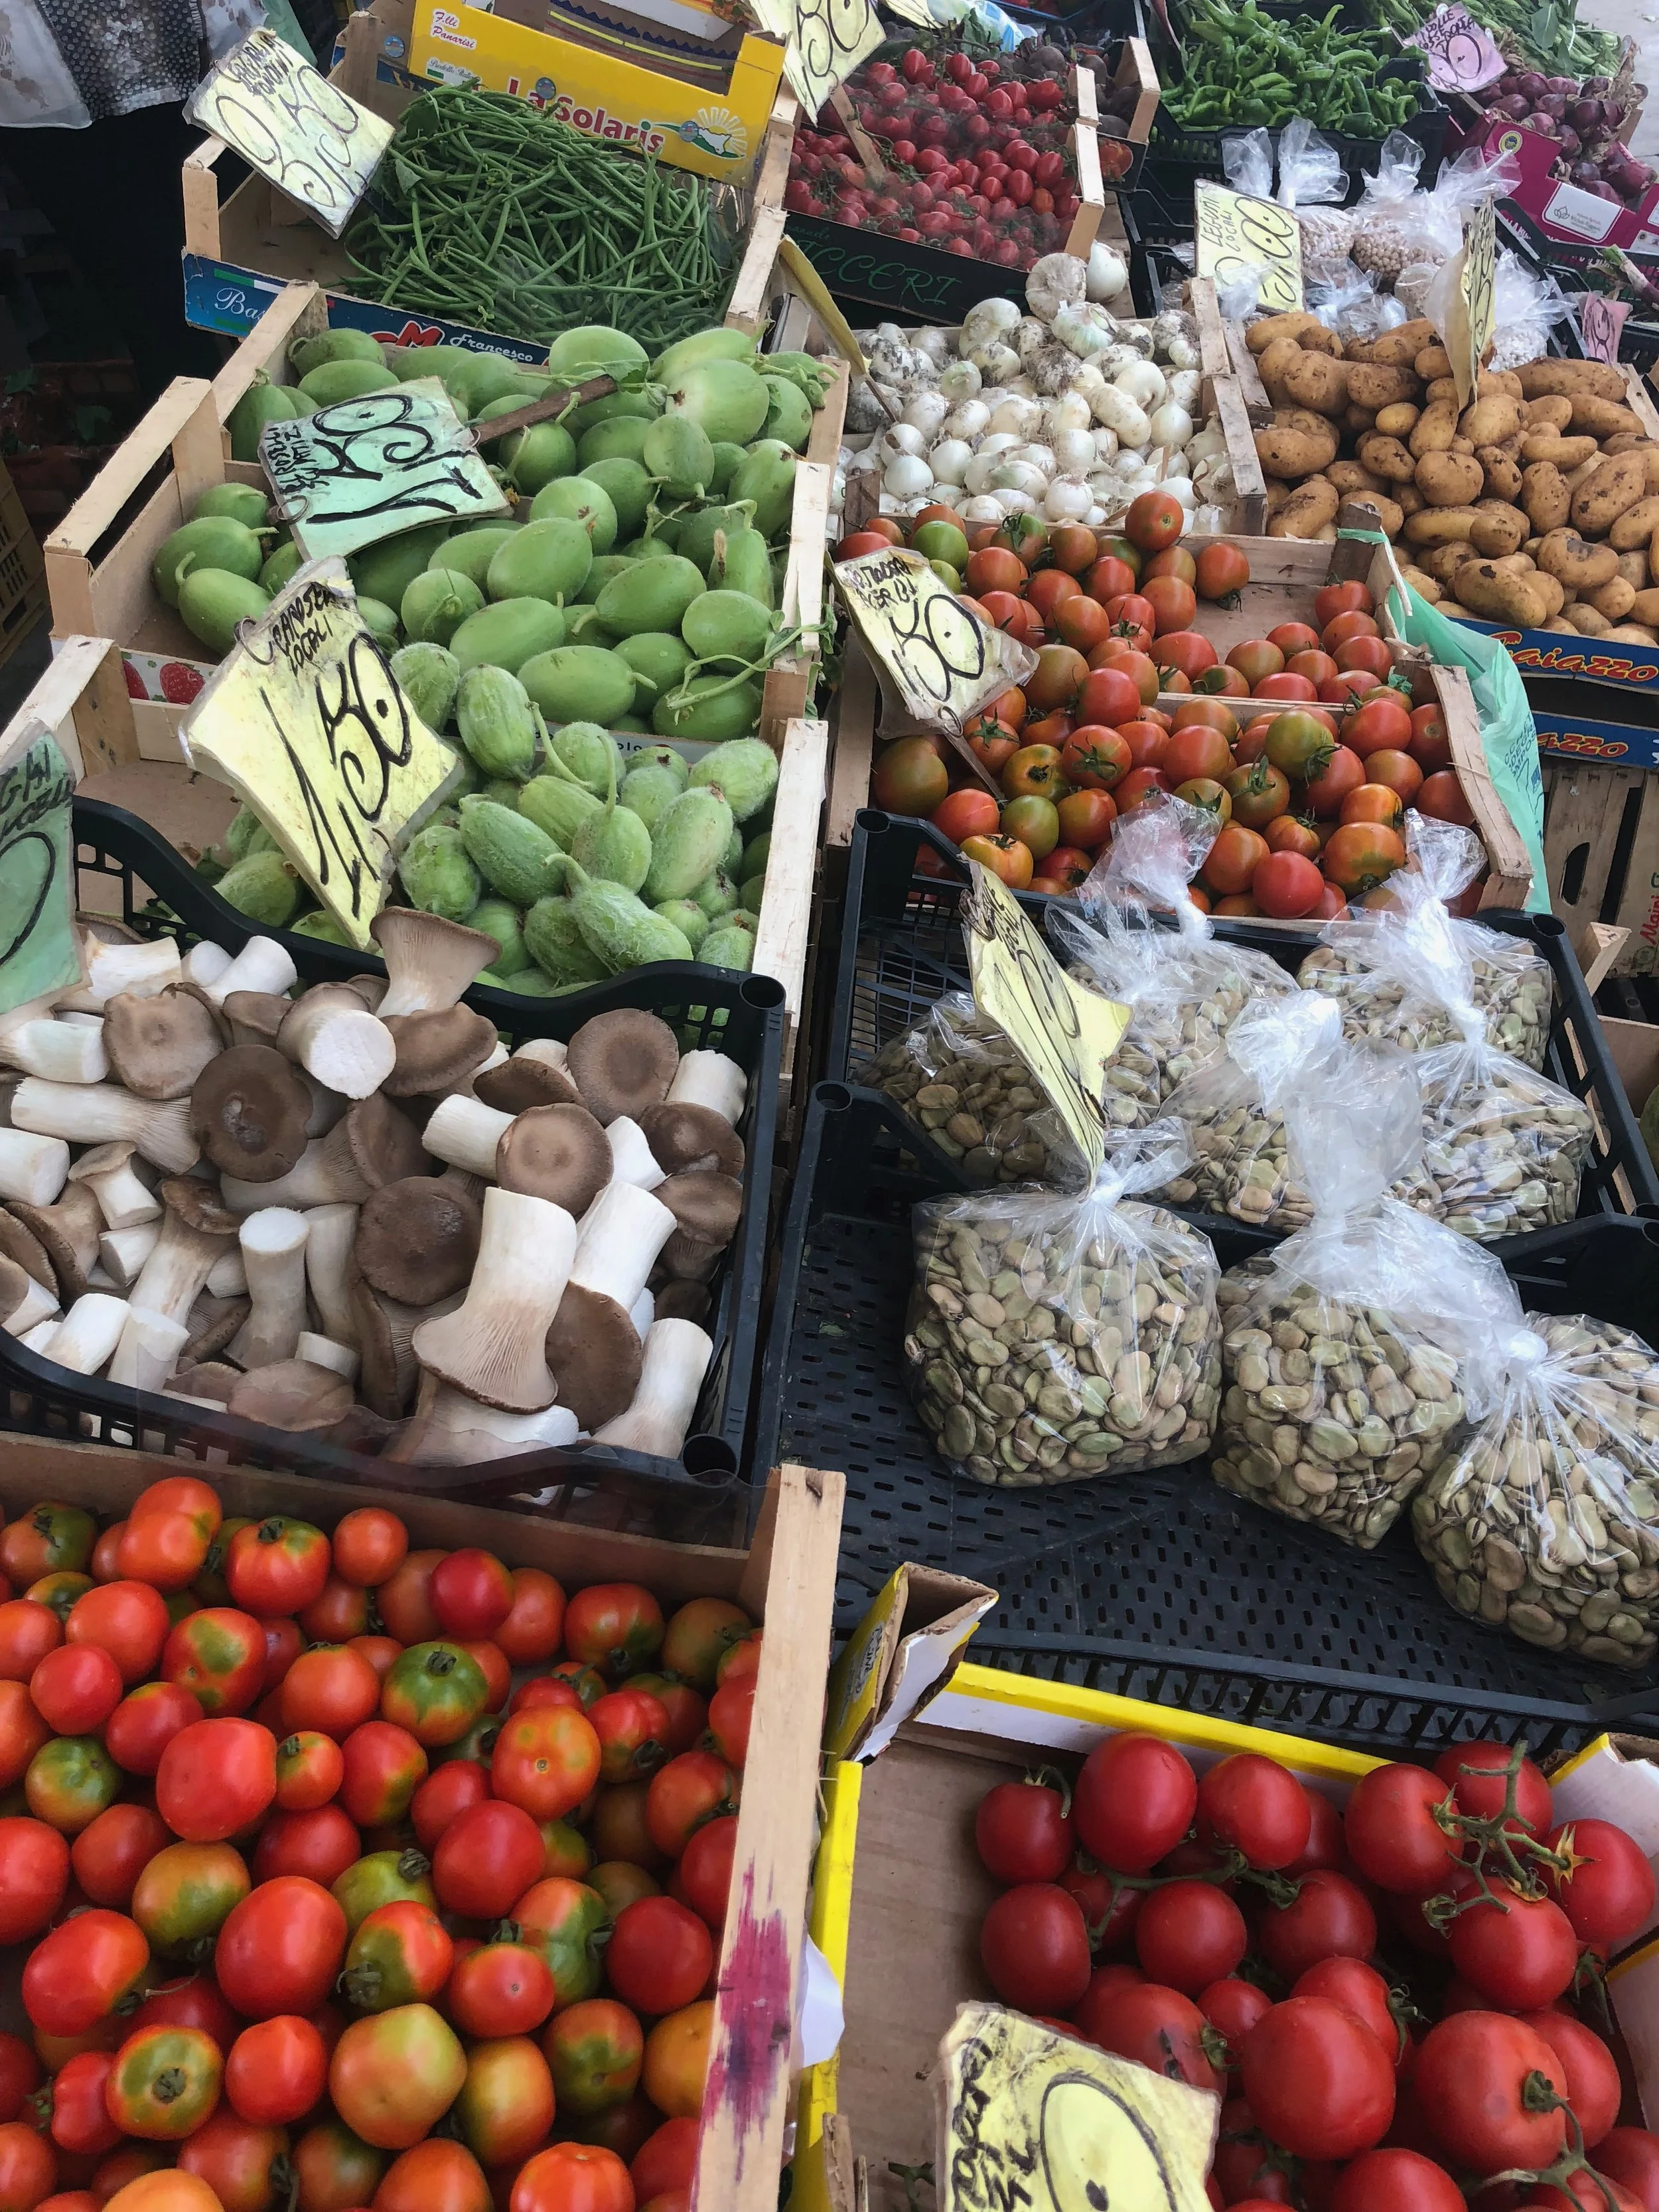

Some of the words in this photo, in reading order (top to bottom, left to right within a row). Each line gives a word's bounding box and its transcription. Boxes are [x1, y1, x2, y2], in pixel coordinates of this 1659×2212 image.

[433, 25, 475, 49] Panarisi
[555, 96, 664, 153] Solaris
[1200, 196, 1222, 248] LEGUMI
[449, 333, 534, 362] Francesco
